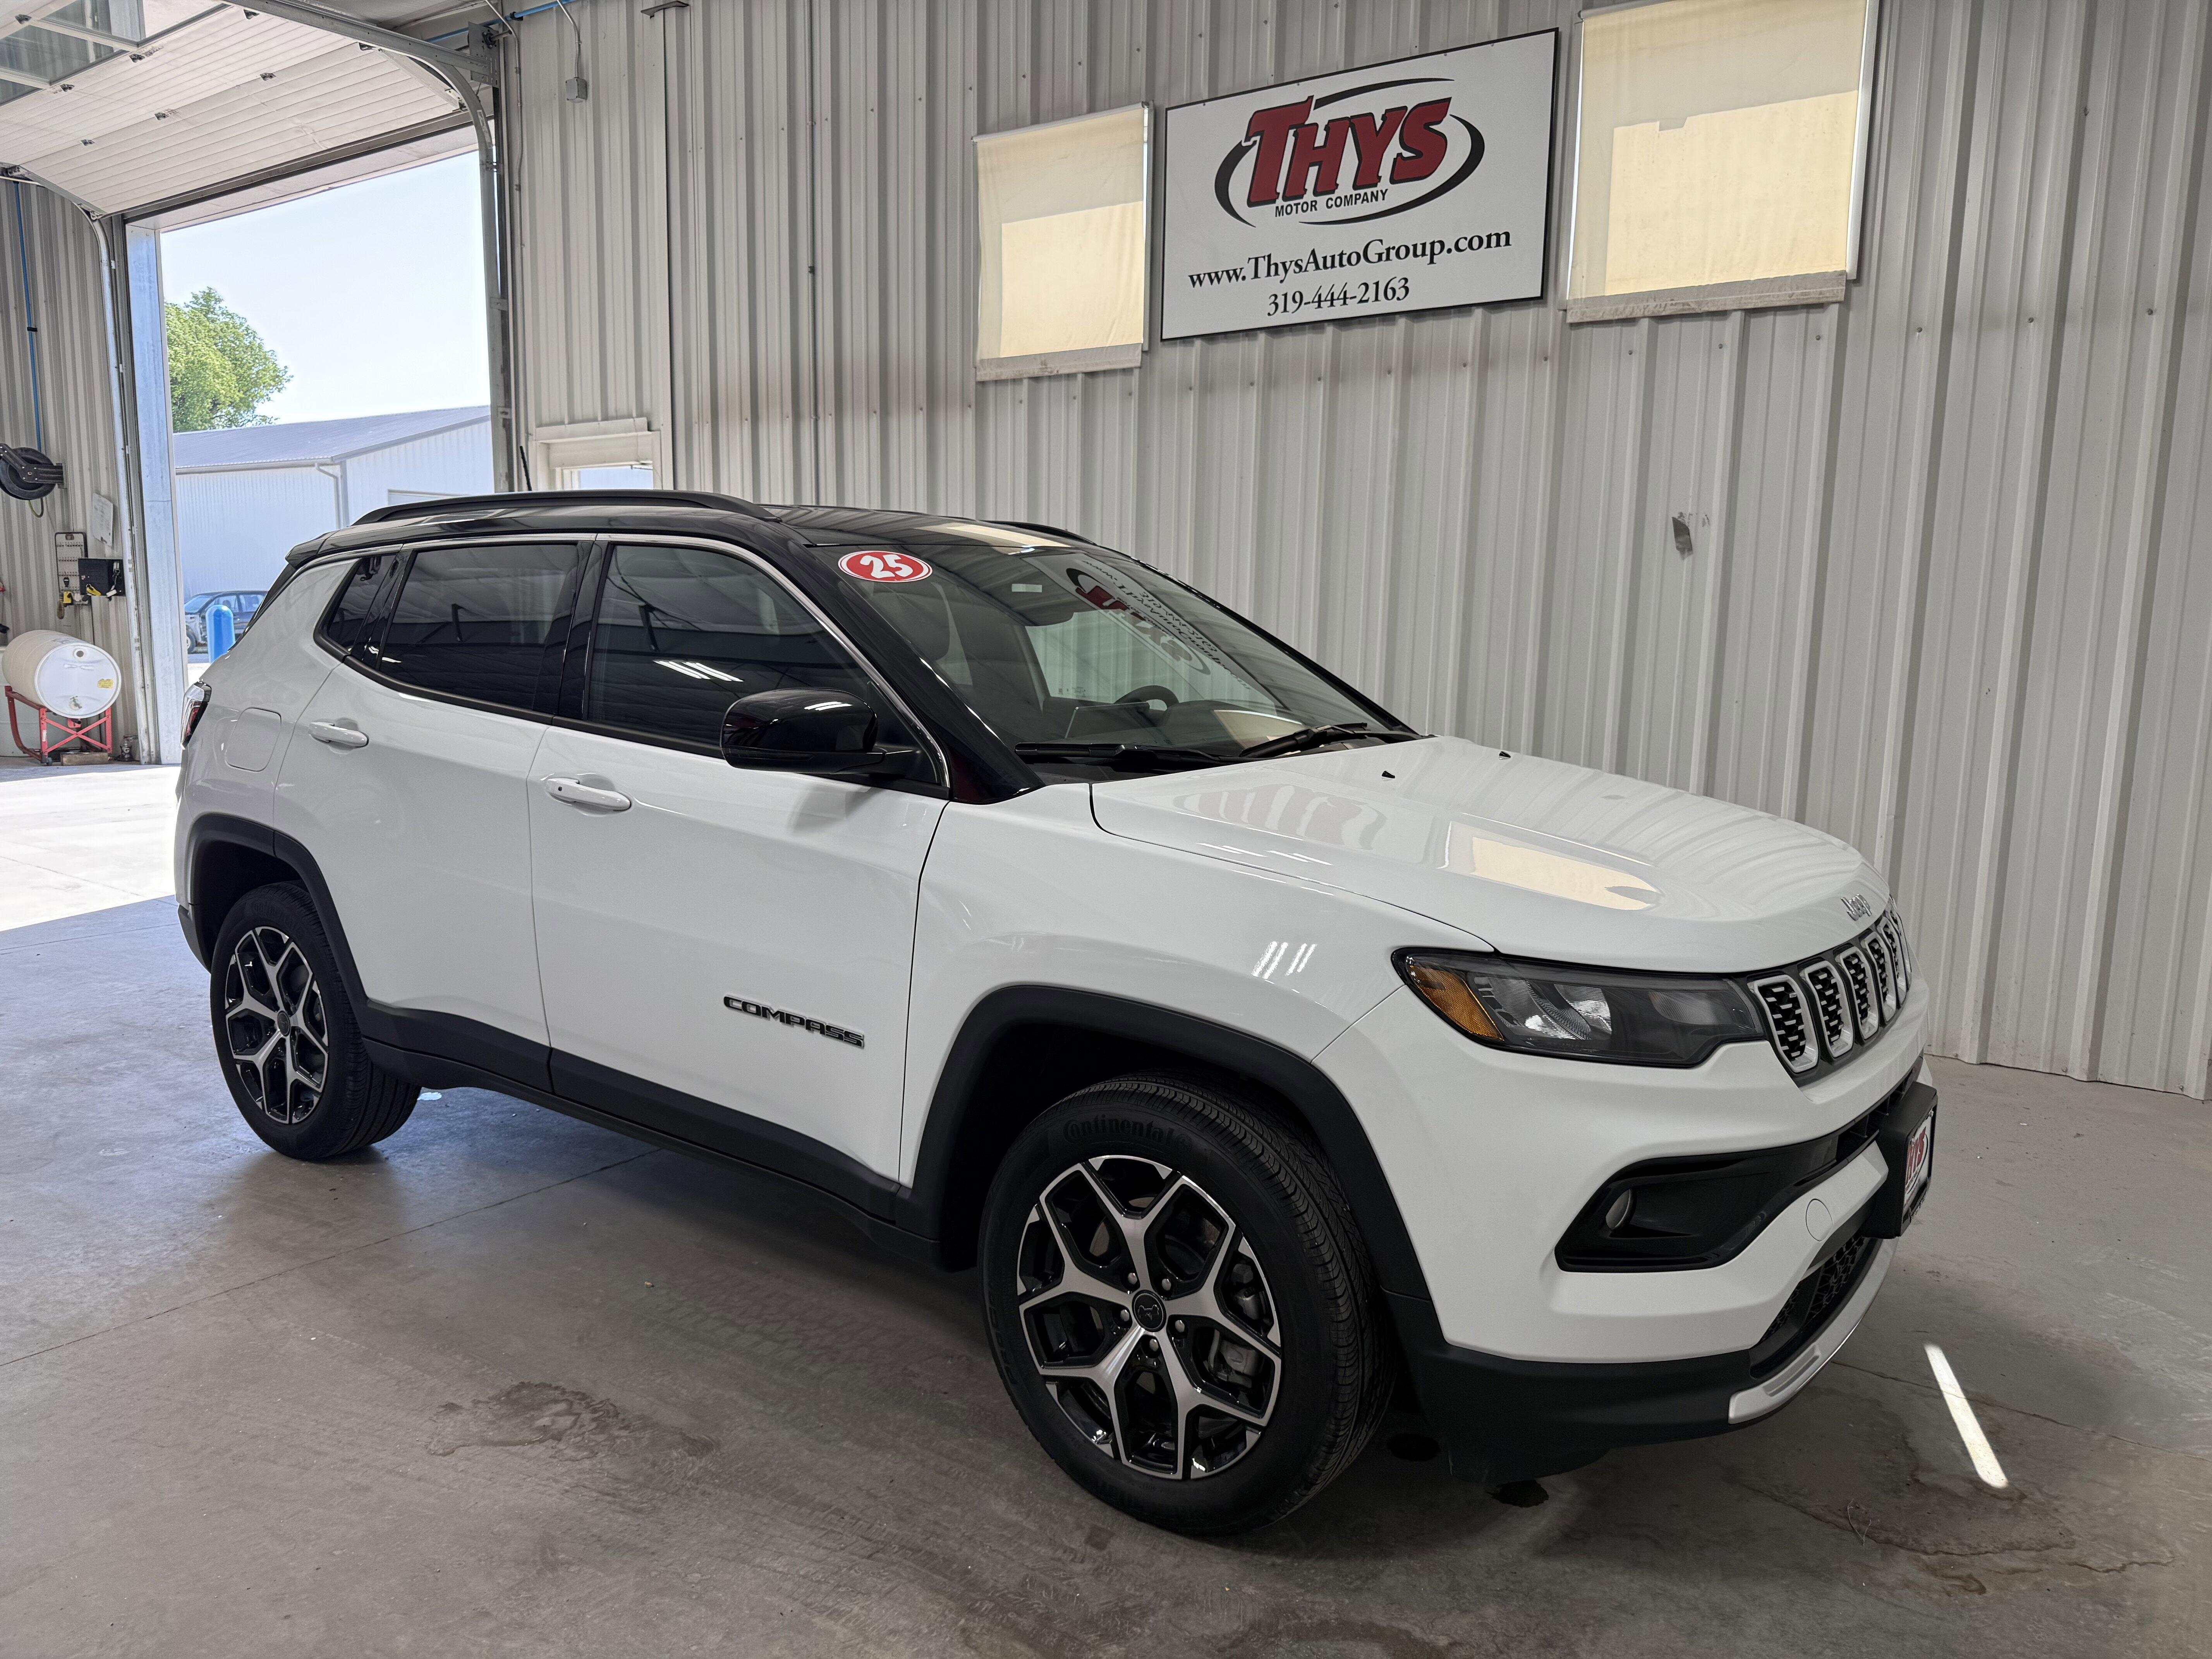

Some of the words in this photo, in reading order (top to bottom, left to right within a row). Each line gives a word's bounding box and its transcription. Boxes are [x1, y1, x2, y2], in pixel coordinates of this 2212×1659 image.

[1244, 95, 1451, 208] THYS
[1275, 200, 1317, 217] MOTOR
[1326, 189, 1388, 209] COMPANY
[1188, 231, 1512, 288] www.ThysAutoGroup.com
[1267, 276, 1410, 316] 319-444-2163
[860, 555, 914, 578] 25
[723, 994, 865, 1049] COMPASS
